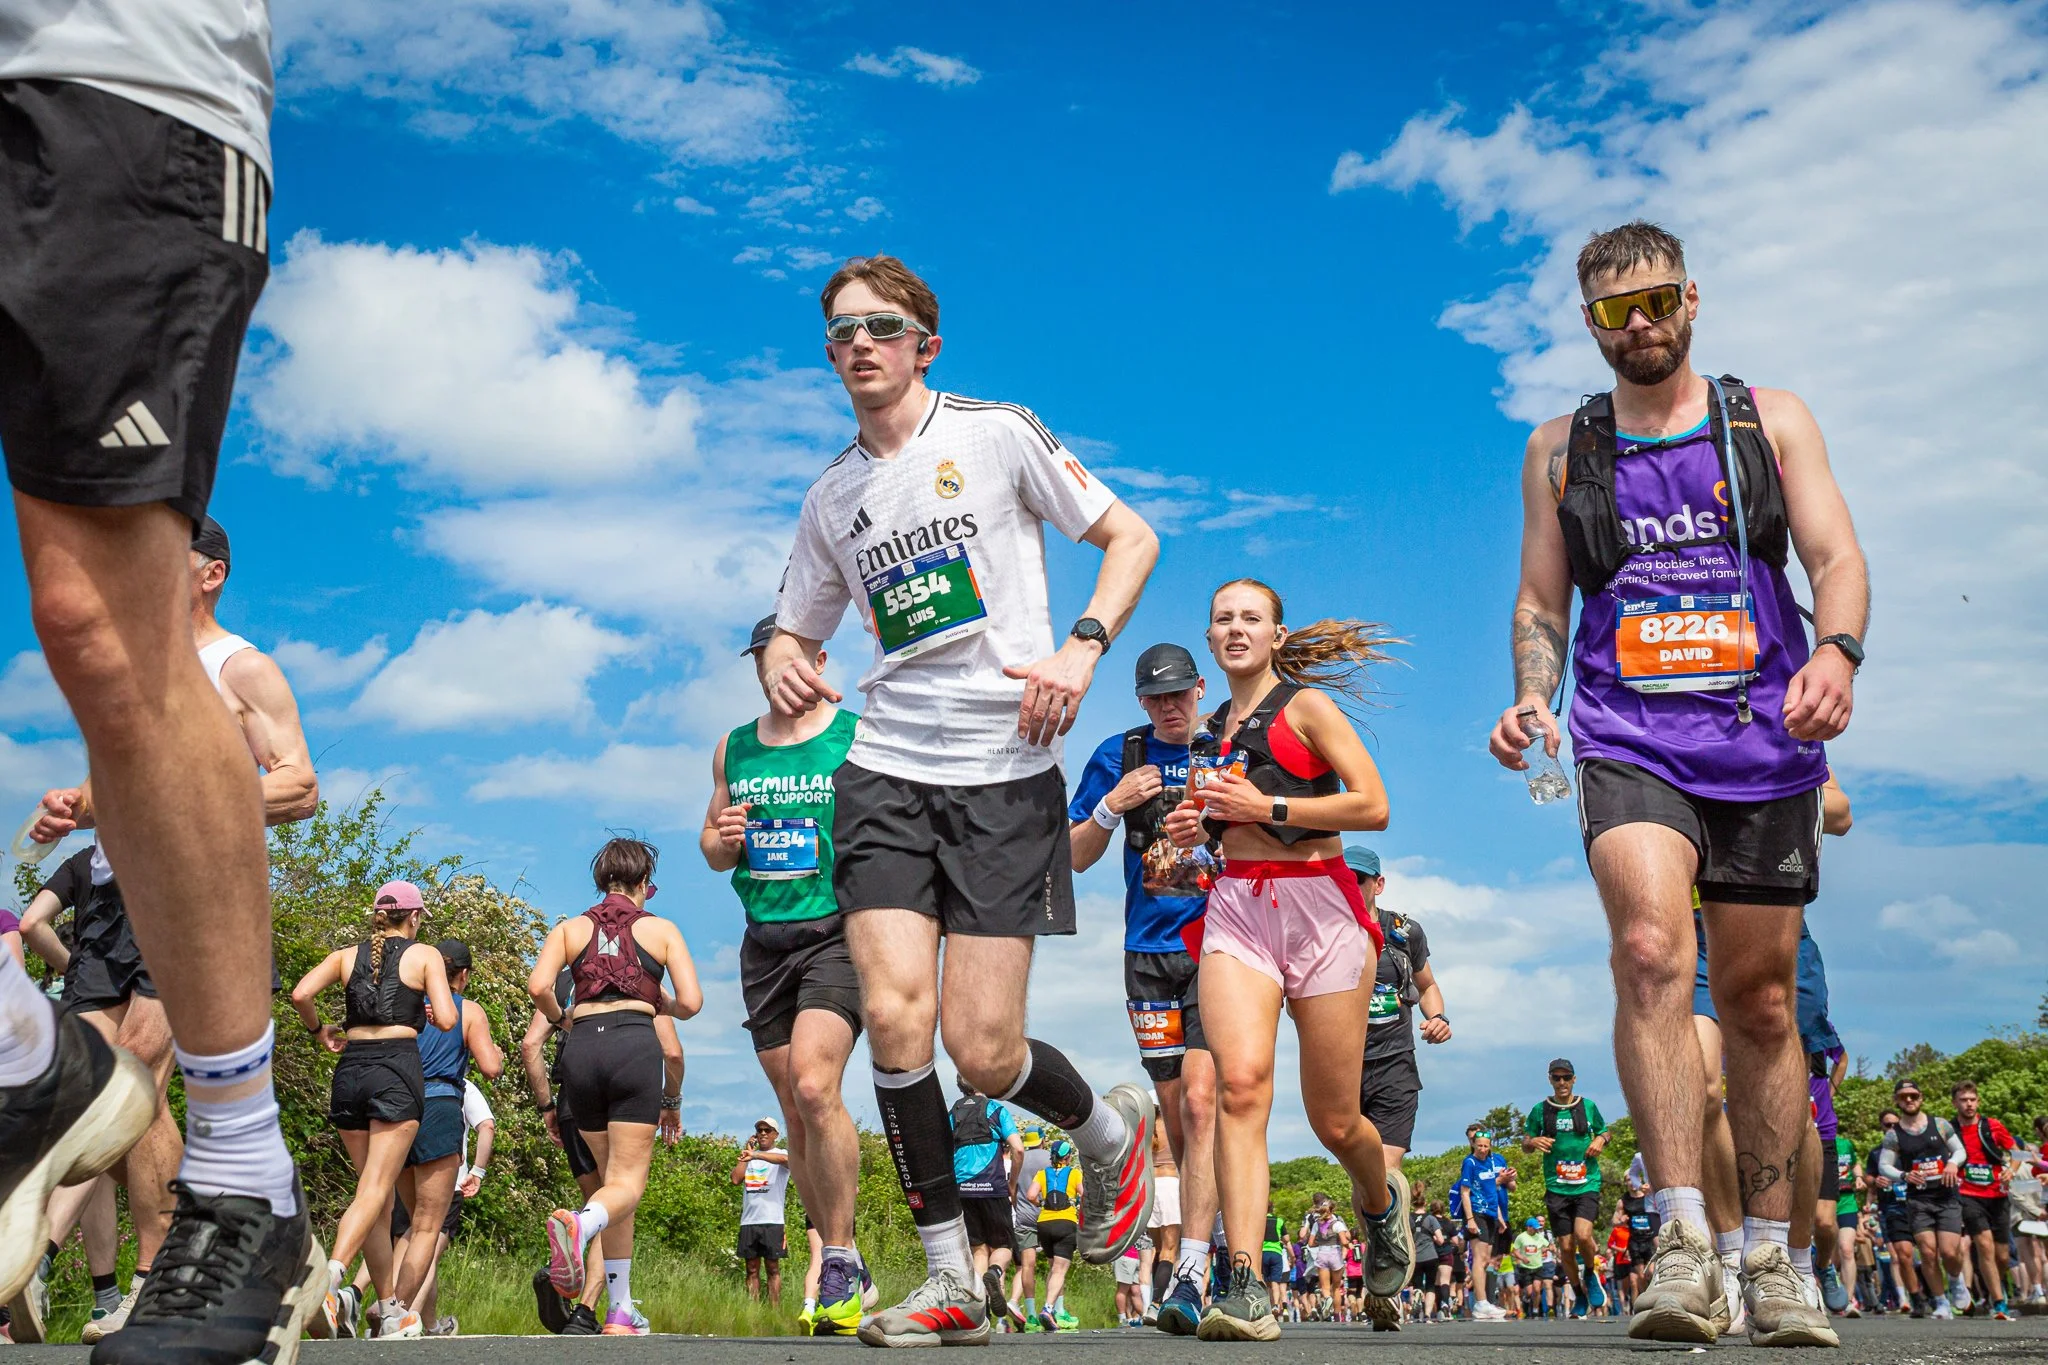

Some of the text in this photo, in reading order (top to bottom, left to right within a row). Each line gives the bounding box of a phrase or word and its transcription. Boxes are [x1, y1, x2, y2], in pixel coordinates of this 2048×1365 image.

[856, 512, 979, 580] Emirates
[1699, 556, 1727, 567] lives.
[1652, 570, 1708, 582] bereaved
[883, 571, 952, 616] 5554
[1623, 600, 1646, 612] emf
[907, 606, 936, 627] LUIS
[1640, 614, 1729, 643] 8226
[1659, 647, 1713, 662] DAVID
[772, 791, 832, 805] SUPPORT
[751, 831, 806, 848] 12234
[767, 852, 789, 861] JAKE
[1133, 1012, 1169, 1029] 8195
